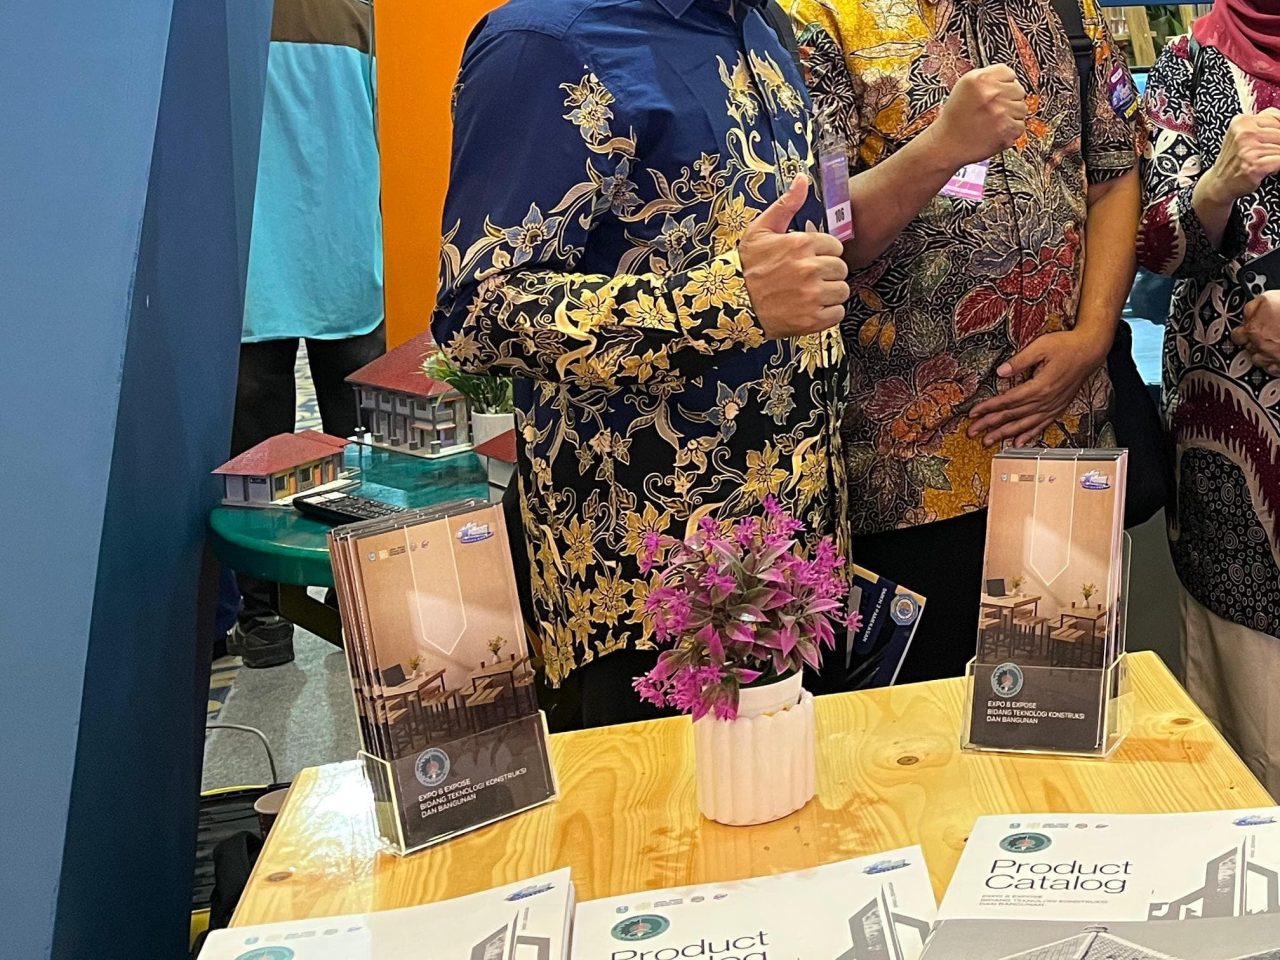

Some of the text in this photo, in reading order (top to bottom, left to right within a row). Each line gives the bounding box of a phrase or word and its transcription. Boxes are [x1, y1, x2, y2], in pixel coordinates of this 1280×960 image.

[987, 700, 1005, 708] EXPO
[1011, 701, 1037, 709] EXPOSE
[987, 708, 1085, 720] BIDANG TEKNOLOGI KONSTRUKSI
[986, 715, 1038, 724] DAN BANGUNAN
[418, 790, 438, 802] EXPO
[444, 778, 471, 793] EXPOSE
[420, 767, 528, 811] BIDANG TEKNOLOGI KONSTRUKSI
[421, 793, 477, 818] DAN BANGUNAN
[990, 859, 1133, 876] Product
[985, 875, 1128, 894] Catalog
[611, 931, 770, 960] Product
